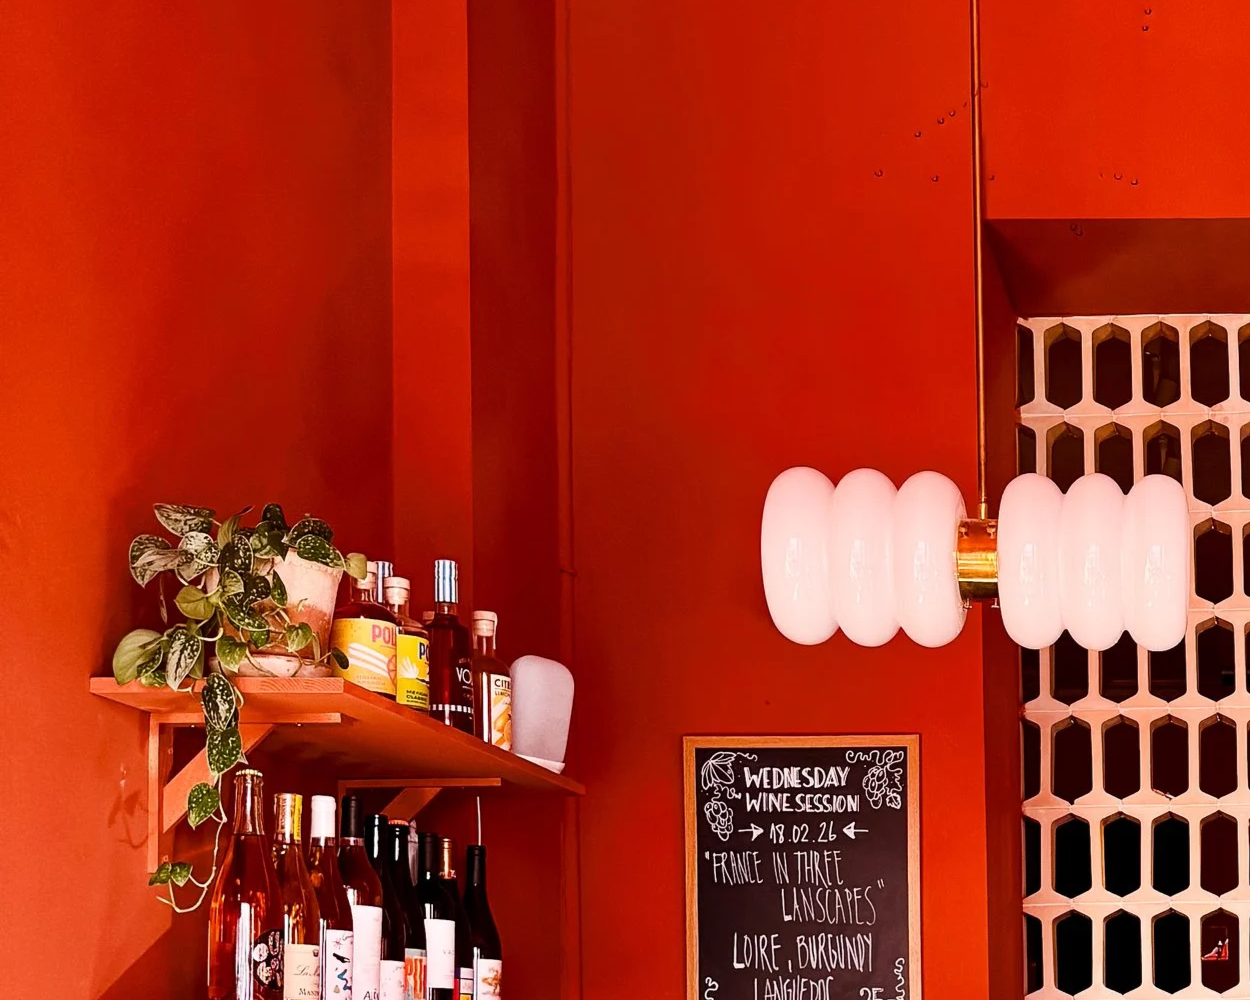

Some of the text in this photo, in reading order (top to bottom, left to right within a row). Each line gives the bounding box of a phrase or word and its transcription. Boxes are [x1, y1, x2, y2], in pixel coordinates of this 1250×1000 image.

[743, 766, 850, 789] WEDNESDAY
[745, 792, 860, 813] WINE SESSION
[769, 820, 838, 844] 18.02.26
[772, 851, 790, 885] IN
[793, 850, 844, 888] THREE
[796, 932, 873, 973] BURGUNDY
